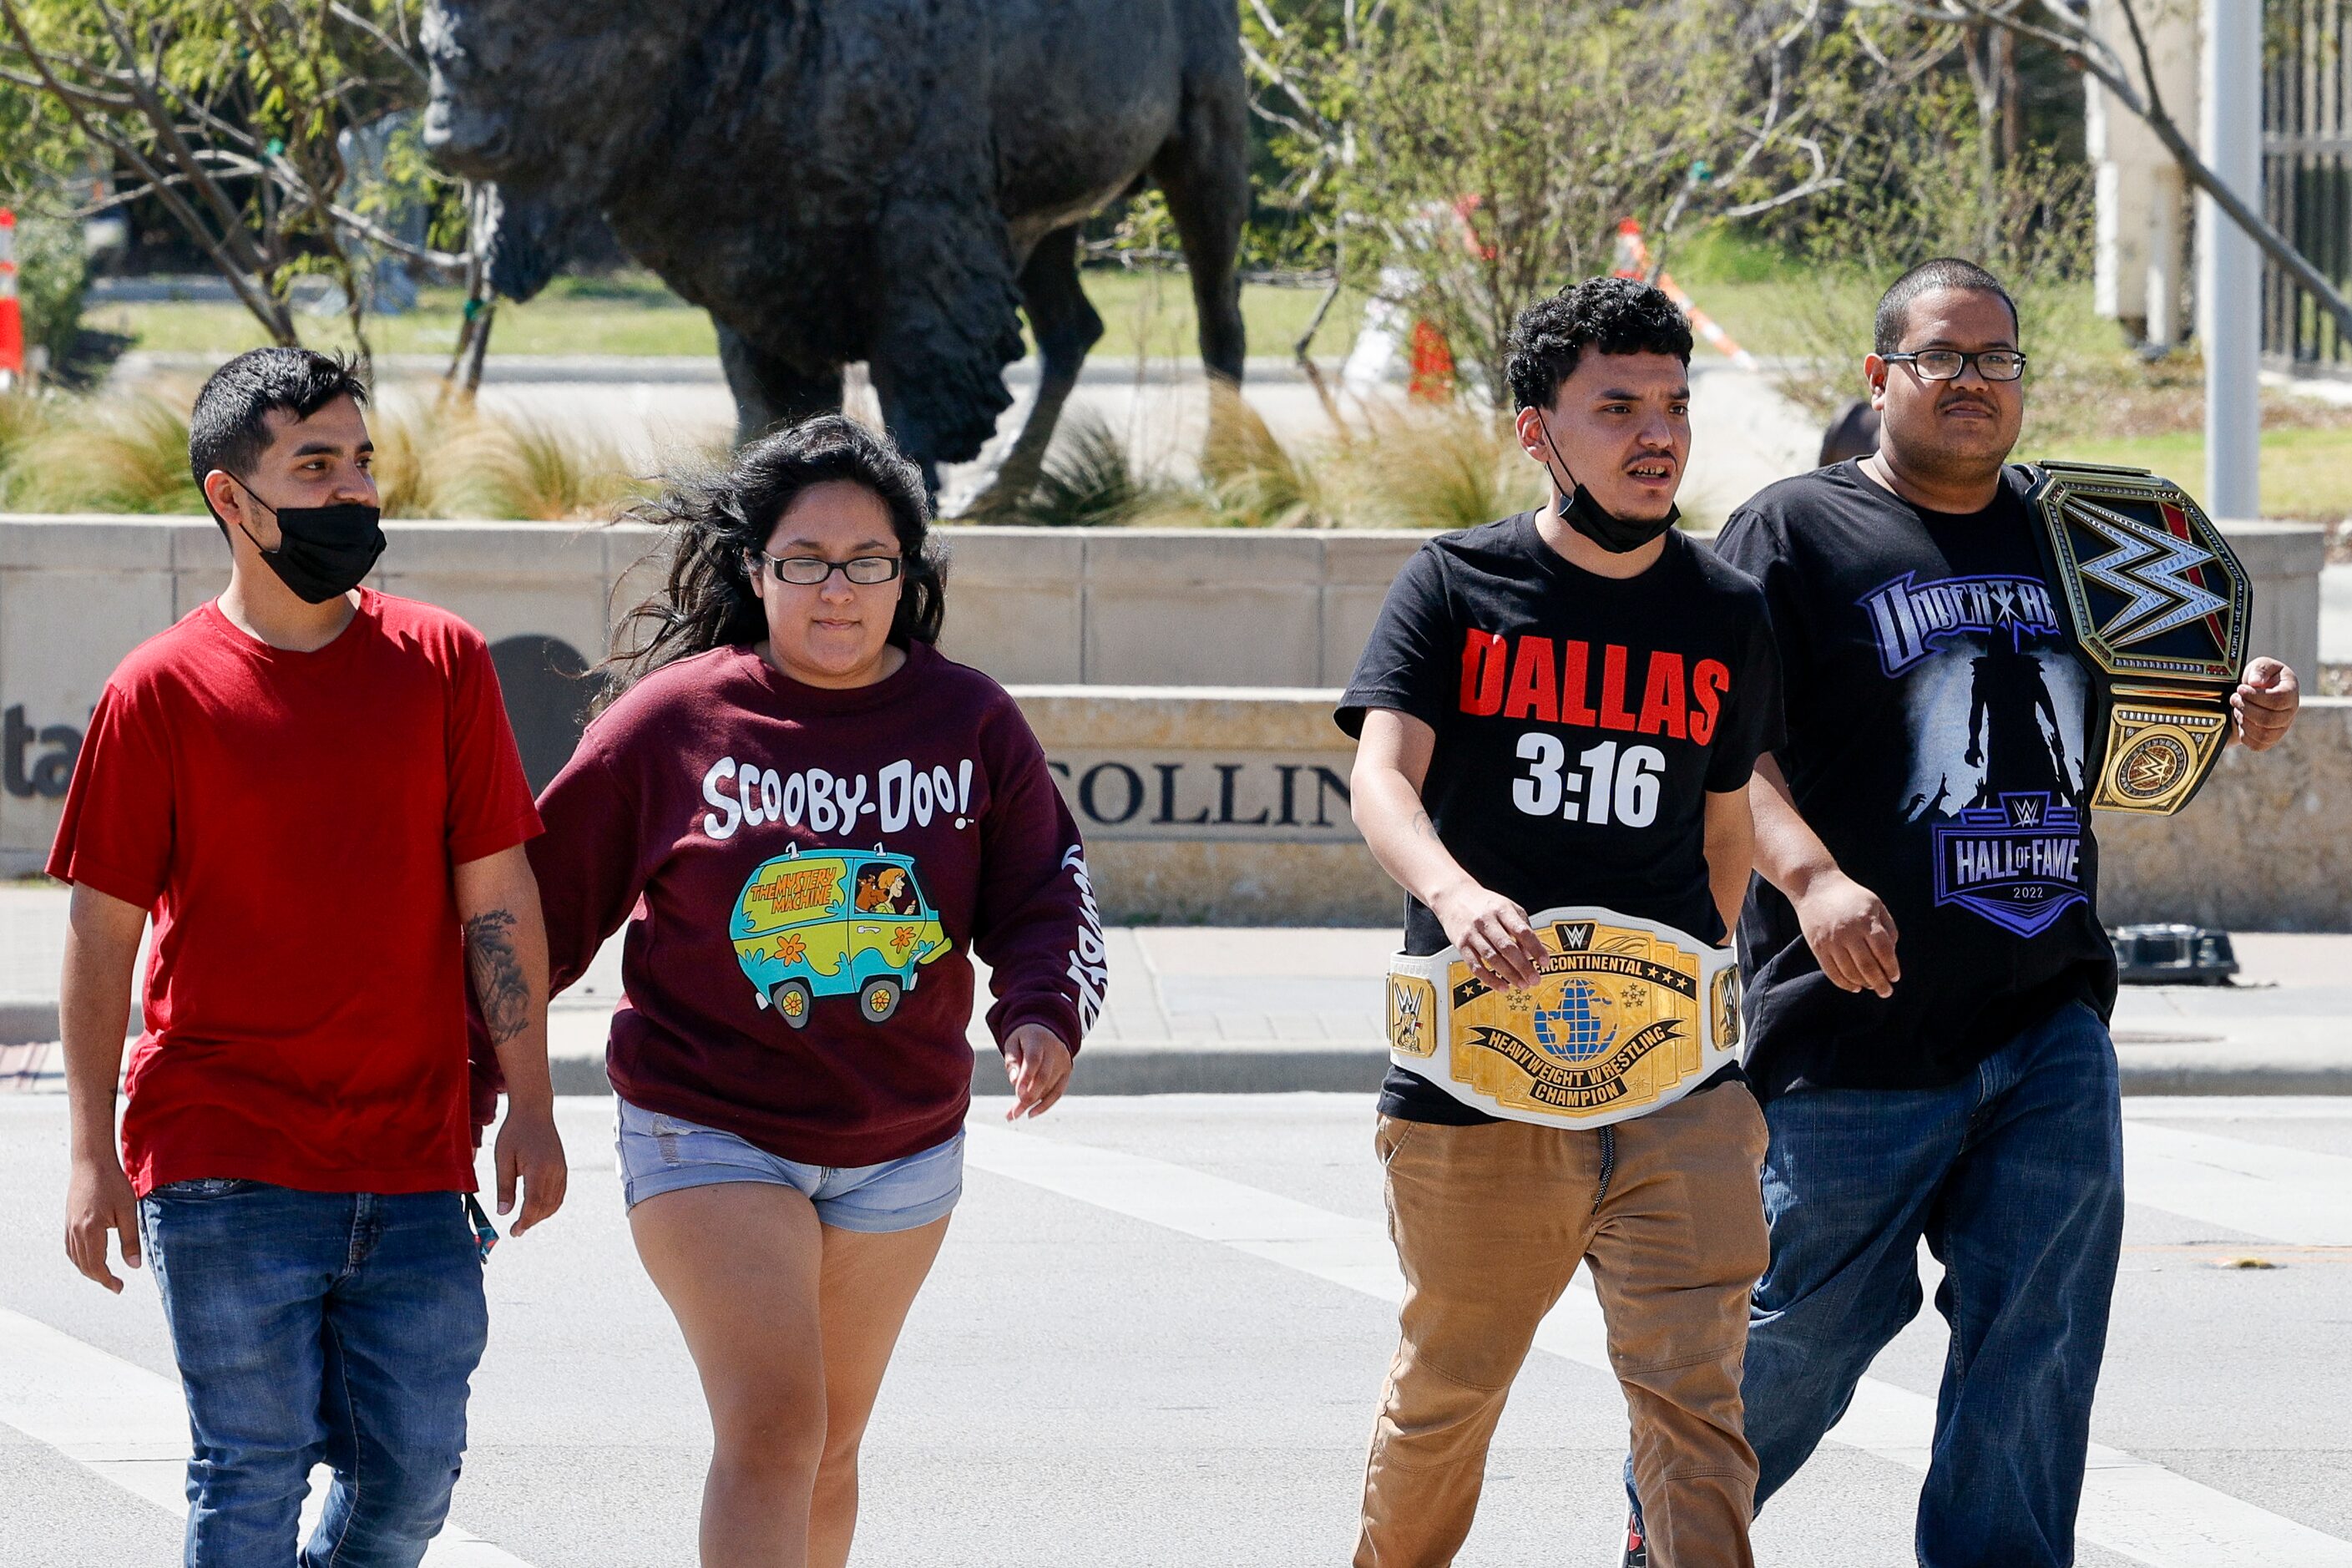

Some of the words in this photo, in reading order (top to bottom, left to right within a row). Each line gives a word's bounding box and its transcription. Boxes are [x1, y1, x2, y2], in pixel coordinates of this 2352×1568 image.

[2229, 626, 2240, 658] WORLD
[1459, 628, 1730, 746] DALLAS
[4, 703, 95, 797] ta
[702, 756, 974, 840] SCOOBY-DOO!
[1048, 761, 1351, 827] OLLIN
[1513, 732, 1666, 828] 3:16
[751, 883, 776, 902] THE
[775, 867, 837, 897] MYSTERY
[1955, 840, 2020, 886] HALL
[2016, 846, 2031, 869] OF
[2032, 838, 2081, 883] FAME
[771, 884, 833, 914] MACHINE
[2013, 887, 2044, 898] 2022
[1489, 1030, 1585, 1087] HEAVYWEIGHT
[1587, 1025, 1666, 1086] WRESTLING
[1535, 1081, 1621, 1107] CHAMPION
